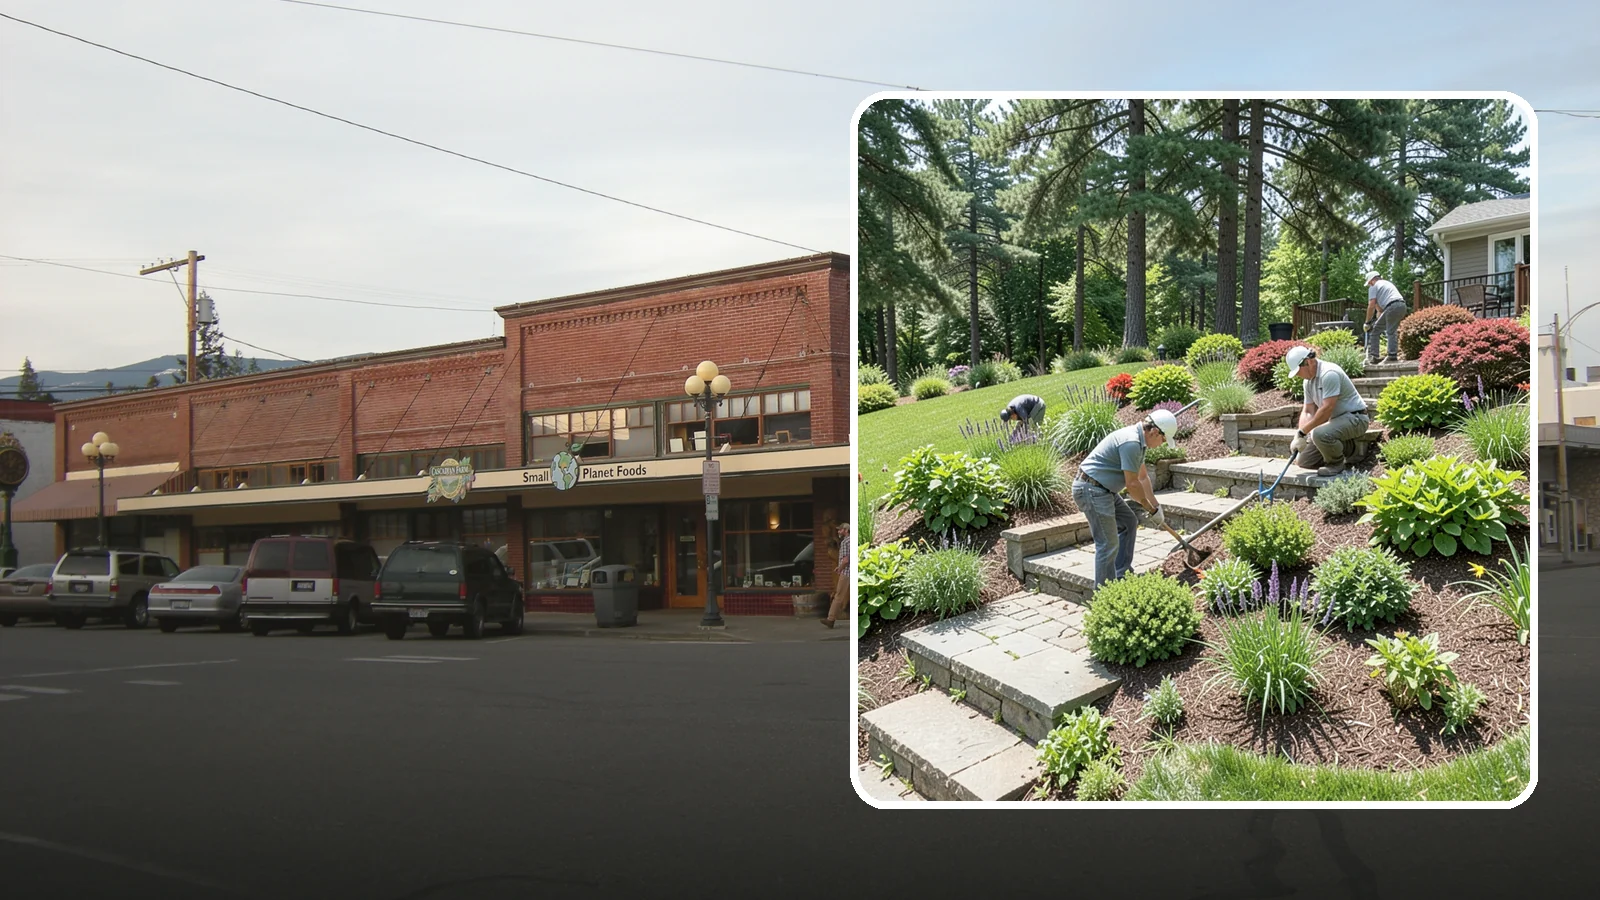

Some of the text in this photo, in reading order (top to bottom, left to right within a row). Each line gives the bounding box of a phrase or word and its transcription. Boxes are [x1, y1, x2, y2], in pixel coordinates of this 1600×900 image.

[523, 464, 647, 483] Small Planet Foods
